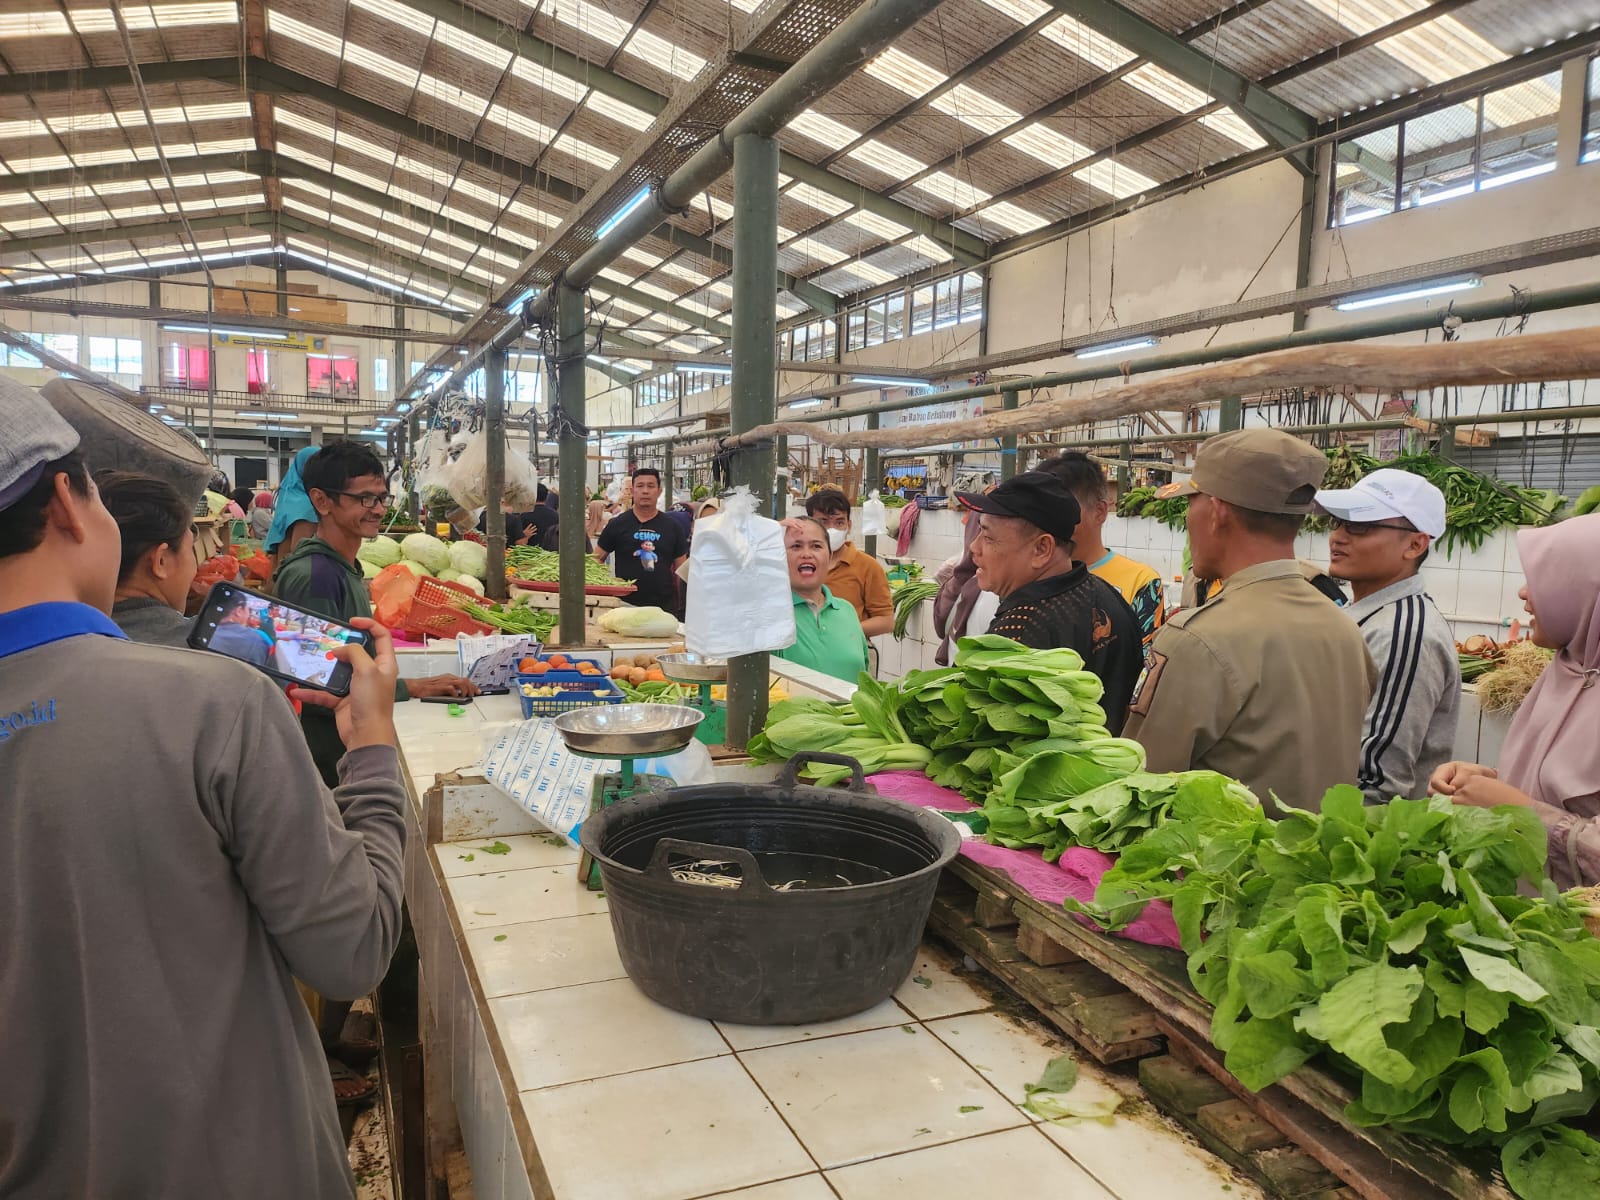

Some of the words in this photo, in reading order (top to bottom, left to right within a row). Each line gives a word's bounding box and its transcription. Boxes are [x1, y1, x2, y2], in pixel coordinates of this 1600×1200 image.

[549, 751, 560, 767] BIT
[520, 764, 533, 780] BIT
[537, 776, 550, 792] BIT
[574, 780, 586, 796] BIT
[564, 806, 576, 820] BIT
